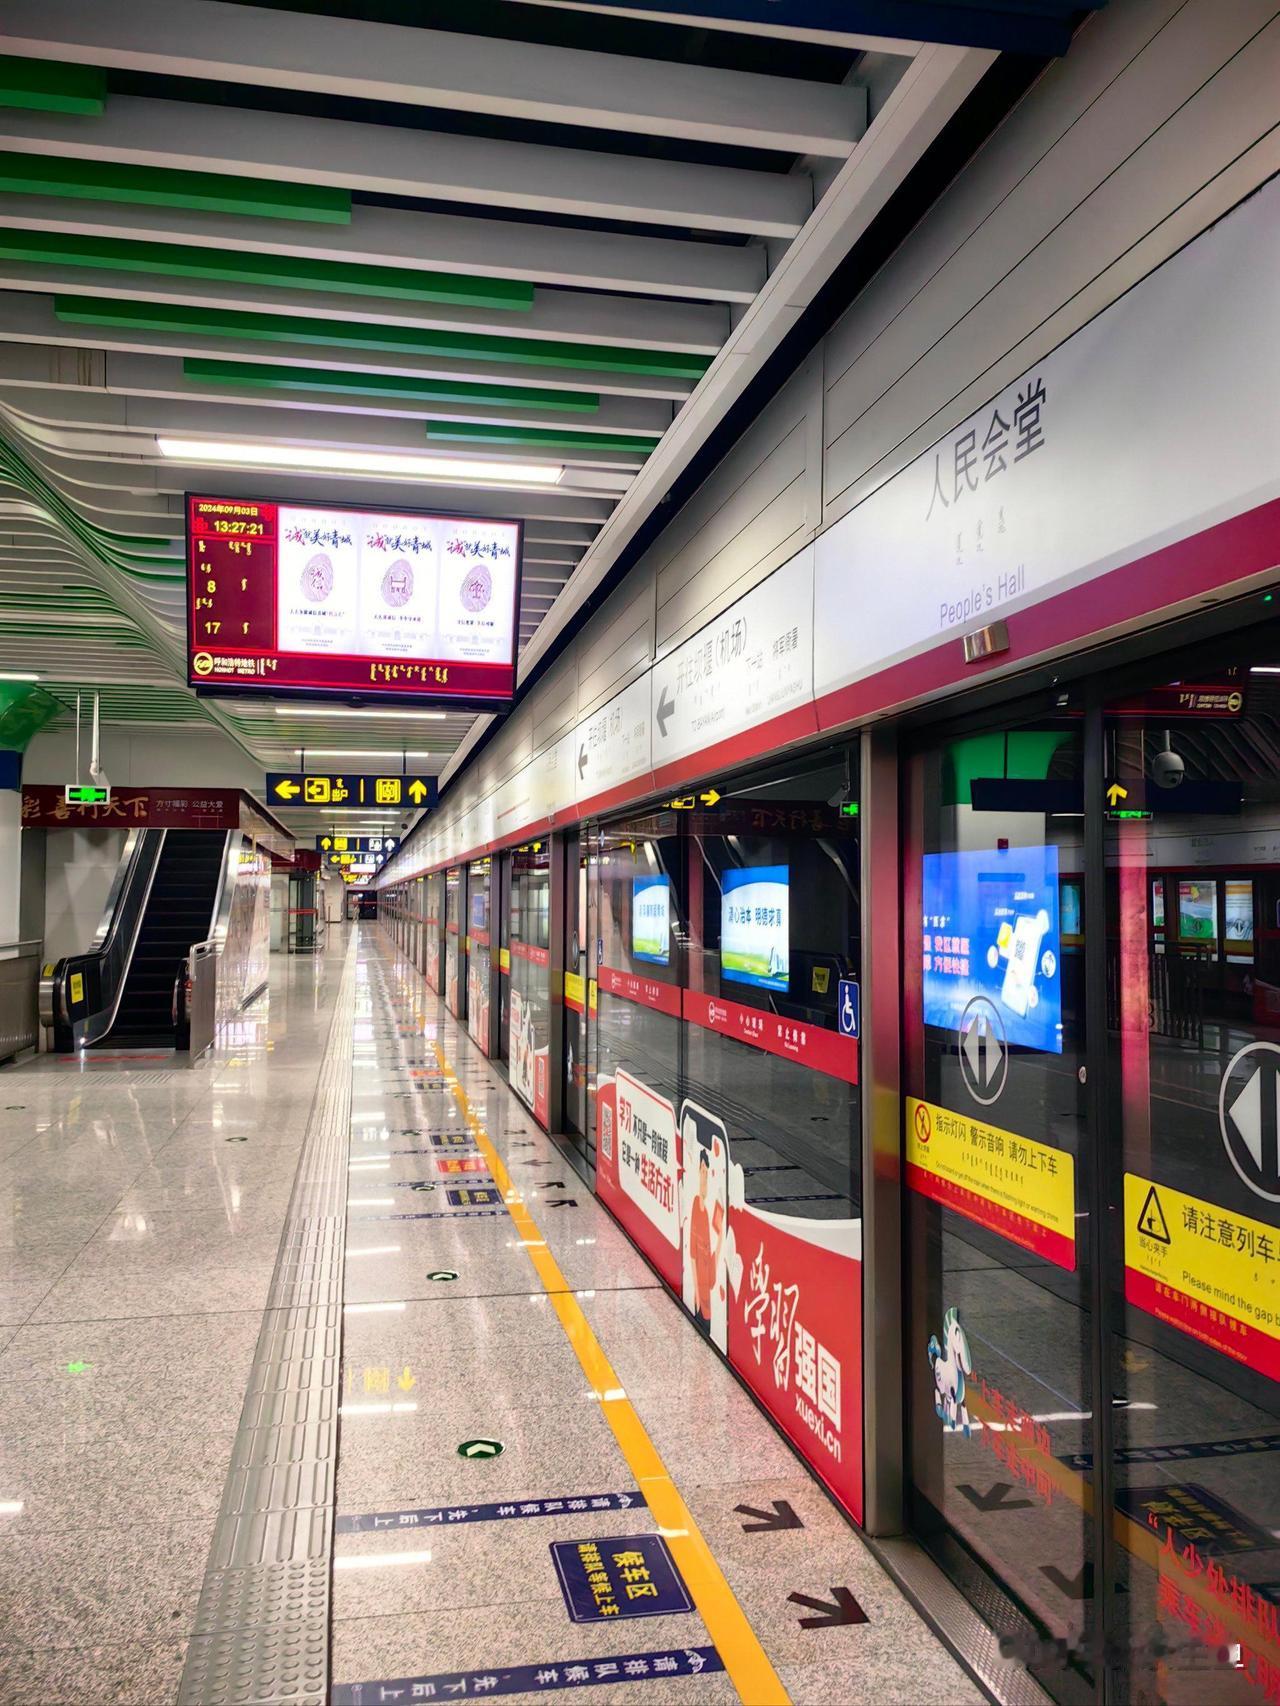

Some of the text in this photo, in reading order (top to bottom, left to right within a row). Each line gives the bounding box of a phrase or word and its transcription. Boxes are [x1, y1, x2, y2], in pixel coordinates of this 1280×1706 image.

[925, 378, 1046, 522] 人民会堂
[198, 503, 259, 516] 2024年09月03日
[214, 520, 263, 535] 13:27:21
[207, 580, 216, 593] 8
[939, 563, 1025, 628] People's Hall
[205, 622, 221, 634] 17
[935, 1113, 967, 1142] 指示灯闪
[970, 1124, 1004, 1157] 警示音响
[1009, 1138, 1058, 1177] 请勿上下车
[1182, 1203, 1280, 1265] 请注意列车
[1182, 1270, 1213, 1296] Please
[1214, 1286, 1236, 1306] mind
[1237, 1295, 1254, 1314] the
[1255, 1306, 1274, 1324] gap
[744, 1241, 841, 1433] 学习强国
[795, 1393, 842, 1463] xuexi.cn
[577, 1542, 620, 1616] 请排队等候上车
[611, 1551, 659, 1600] 候车区
